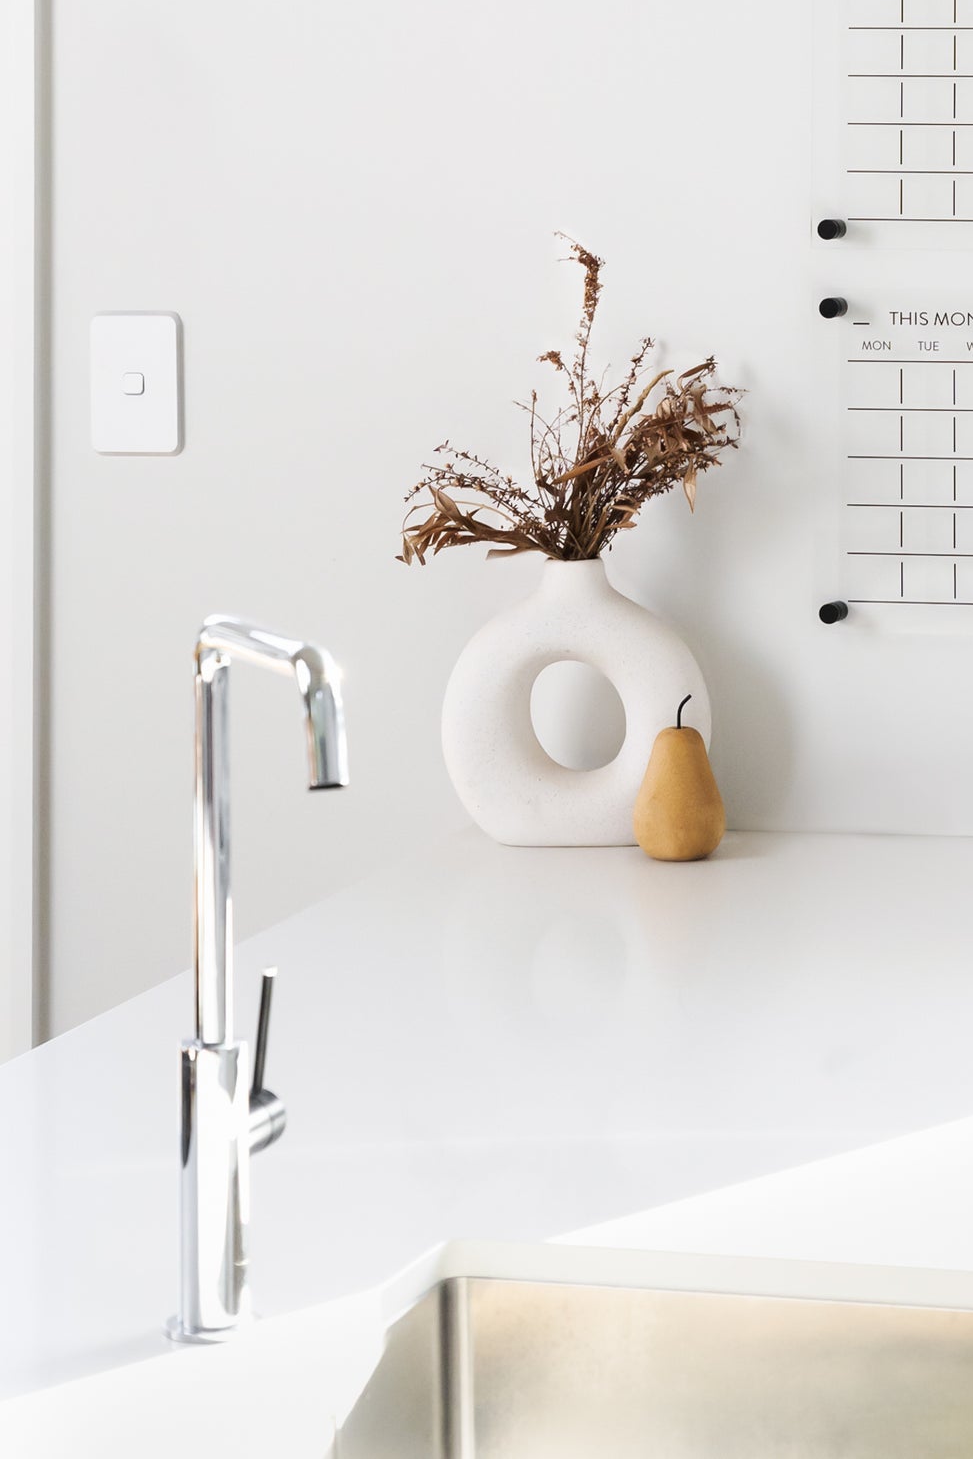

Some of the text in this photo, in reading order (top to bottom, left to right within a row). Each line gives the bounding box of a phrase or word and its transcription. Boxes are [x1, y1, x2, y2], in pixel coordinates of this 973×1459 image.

[888, 311, 929, 327] THIS
[861, 340, 892, 351] MON
[917, 340, 940, 352] TUE
